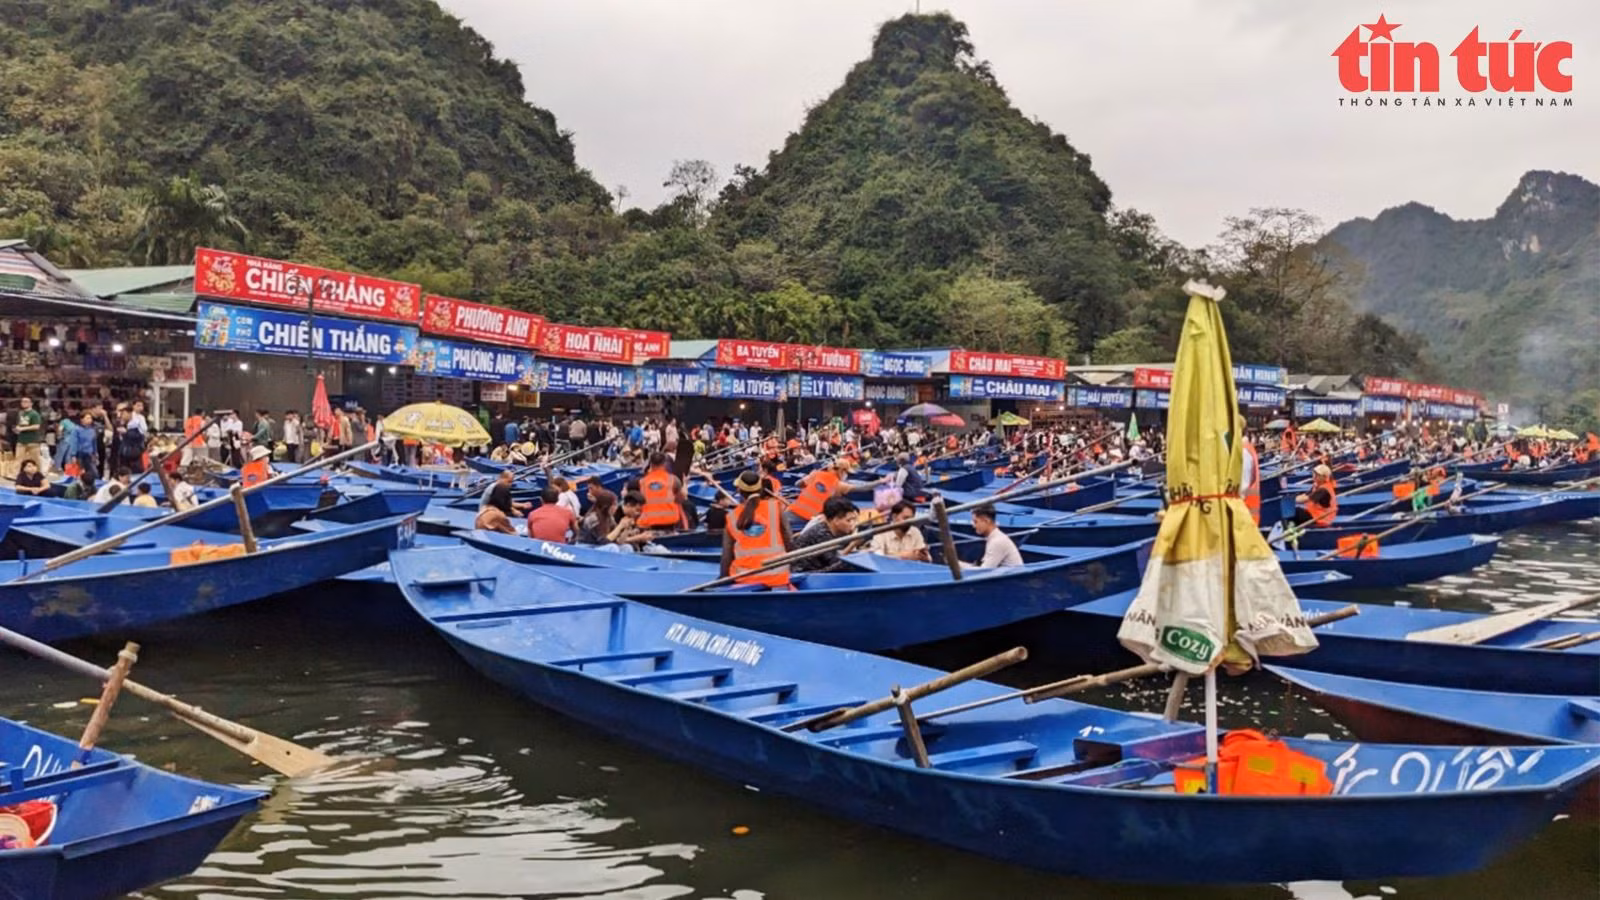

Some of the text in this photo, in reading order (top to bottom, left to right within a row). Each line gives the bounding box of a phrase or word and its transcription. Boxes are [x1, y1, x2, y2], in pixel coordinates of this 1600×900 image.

[329, 325, 391, 355] THẮNG
[565, 332, 590, 351] HOA
[737, 345, 748, 357] BA
[566, 367, 592, 385] HOA
[593, 368, 623, 387] NHÀI
[733, 379, 745, 394] BA
[986, 380, 1050, 396] CHÂU MAI
[1166, 629, 1209, 660] Cozy
